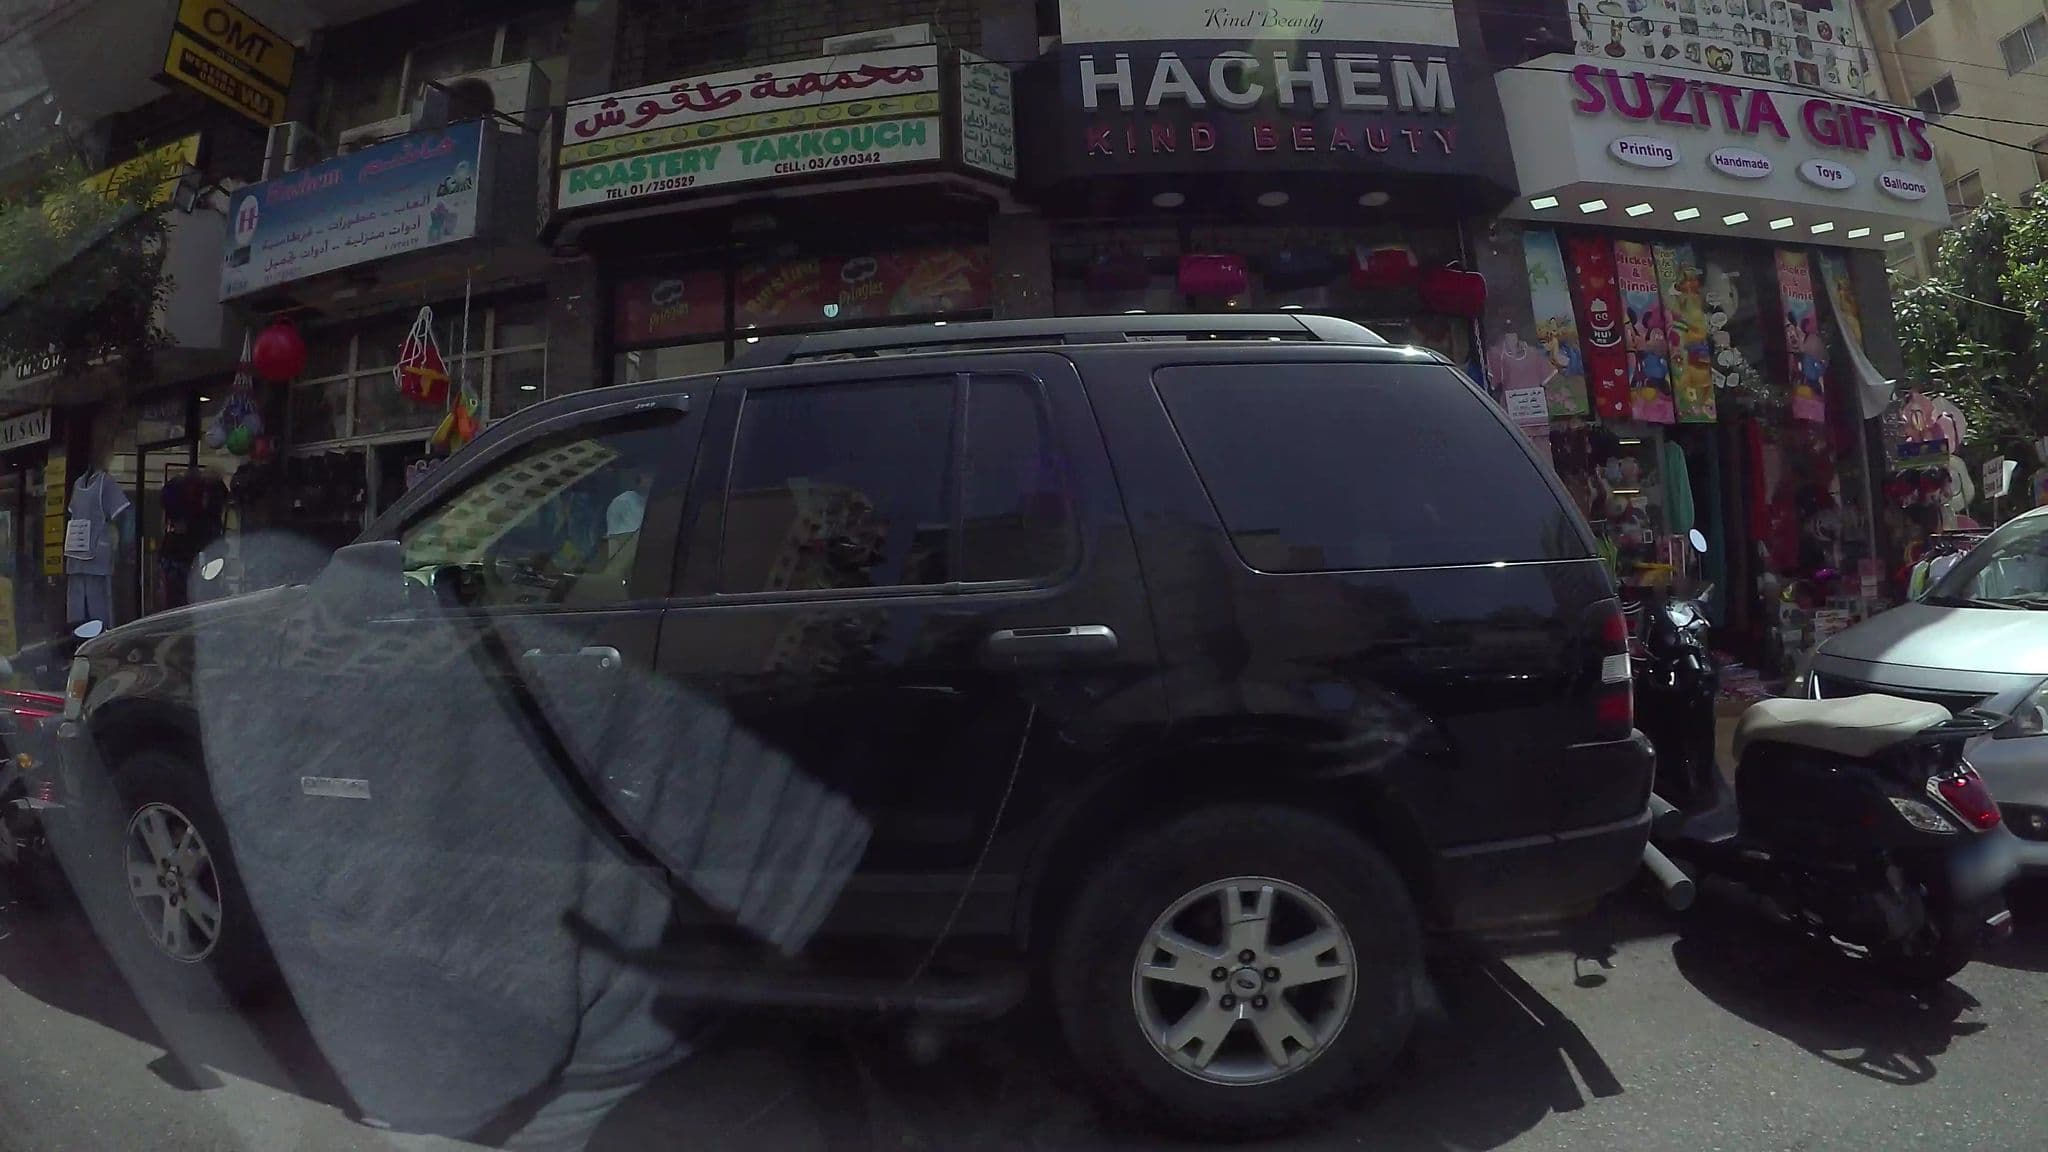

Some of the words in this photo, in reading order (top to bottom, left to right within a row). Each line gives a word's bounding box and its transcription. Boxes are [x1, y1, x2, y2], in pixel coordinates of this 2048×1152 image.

[203, 7, 273, 63] OMT
[1204, 7, 1255, 28] Kind
[1256, 7, 1324, 35] Beauty
[750, 64, 924, 99] محمصة
[1079, 50, 1457, 113] HACHEM
[574, 81, 742, 138] طقوش
[1086, 121, 1218, 157] KIND
[1250, 121, 1457, 156] BEAUTY
[1618, 140, 1673, 161] Printing
[568, 145, 722, 194] ROASTERY
[737, 121, 926, 166] TAKKOUCH
[808, 151, 881, 171] 03/690342
[1714, 154, 1769, 171] Handmade
[629, 175, 696, 196] 01/750529
[1814, 164, 1843, 182] Toys
[1883, 175, 1927, 195] Balloons
